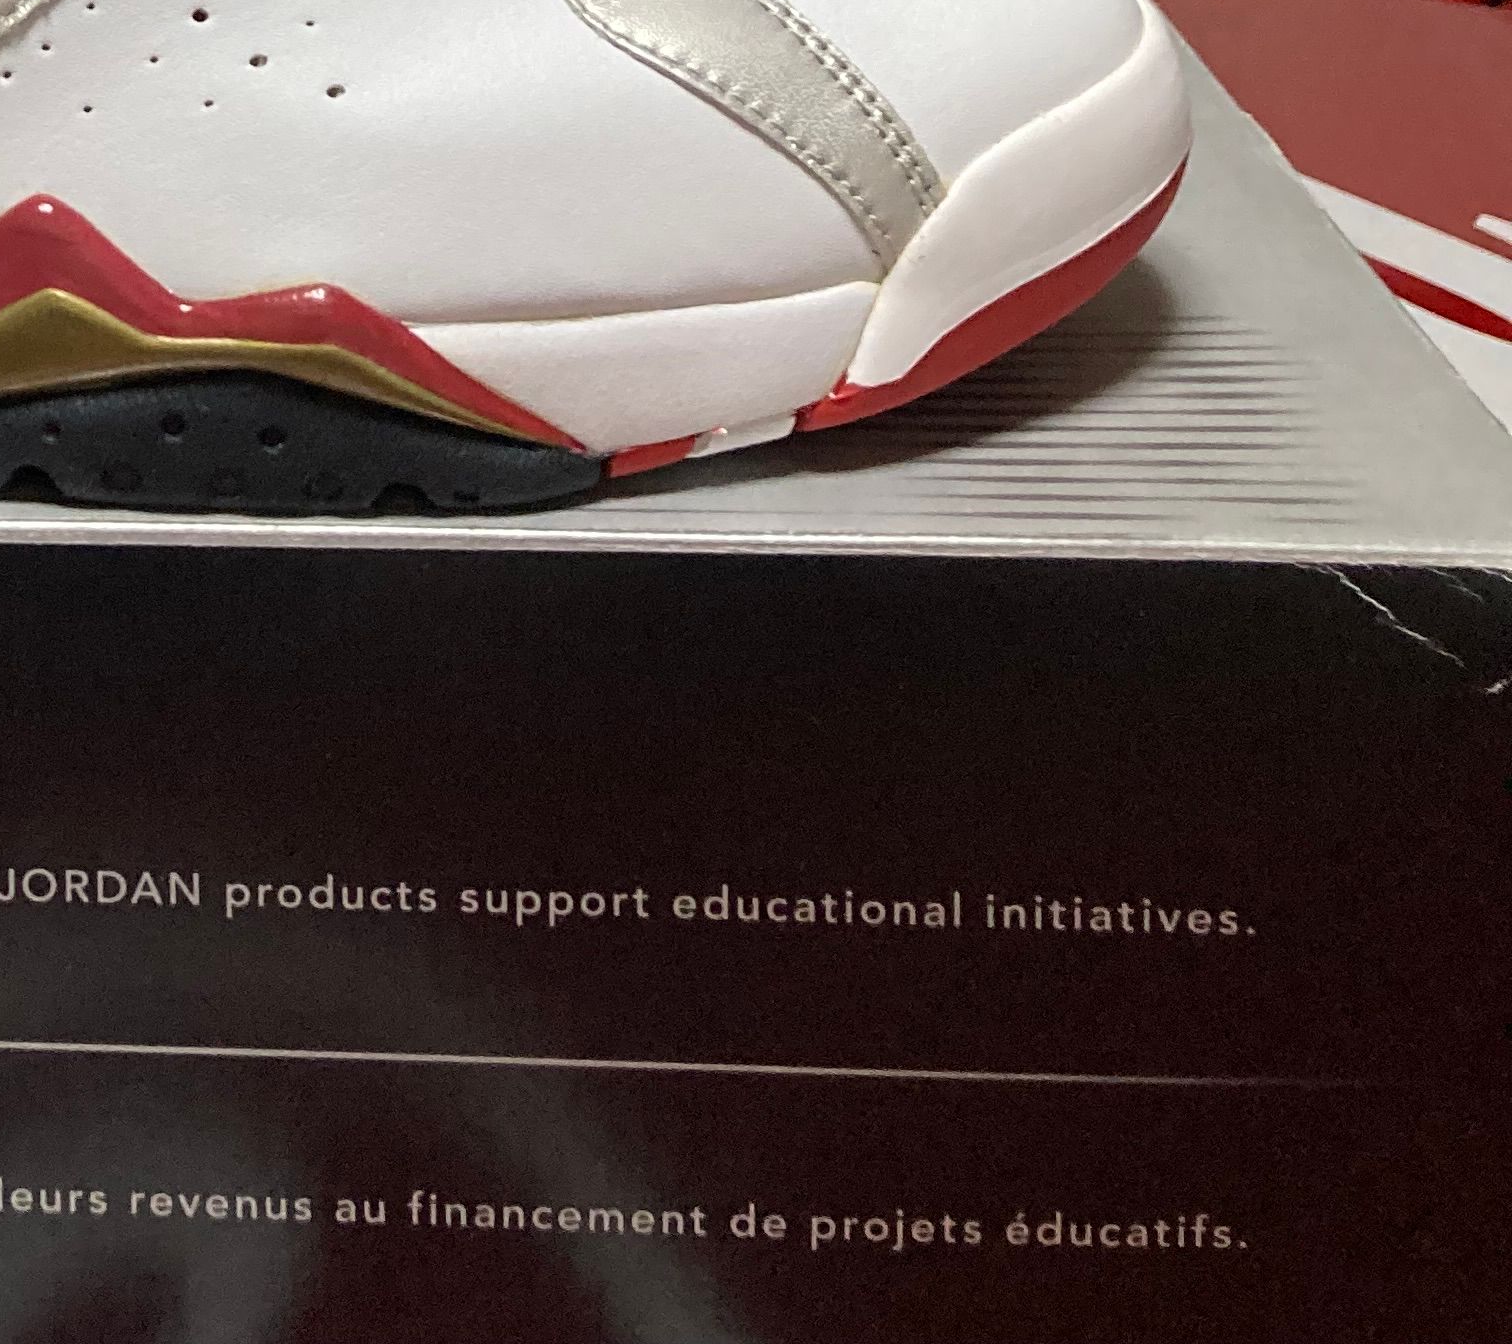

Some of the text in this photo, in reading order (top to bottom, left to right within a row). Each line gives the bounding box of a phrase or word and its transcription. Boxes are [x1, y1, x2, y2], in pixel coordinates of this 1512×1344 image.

[223, 871, 439, 921] products
[458, 885, 651, 930] support
[670, 881, 963, 930] educational
[984, 891, 1258, 937] initiatives.
[128, 1189, 314, 1225] revenus
[333, 1196, 388, 1227] au
[405, 1187, 709, 1239] financement
[728, 1199, 789, 1242] de
[808, 1206, 984, 1254] projets
[1003, 1208, 1250, 1251] éducatifs.
